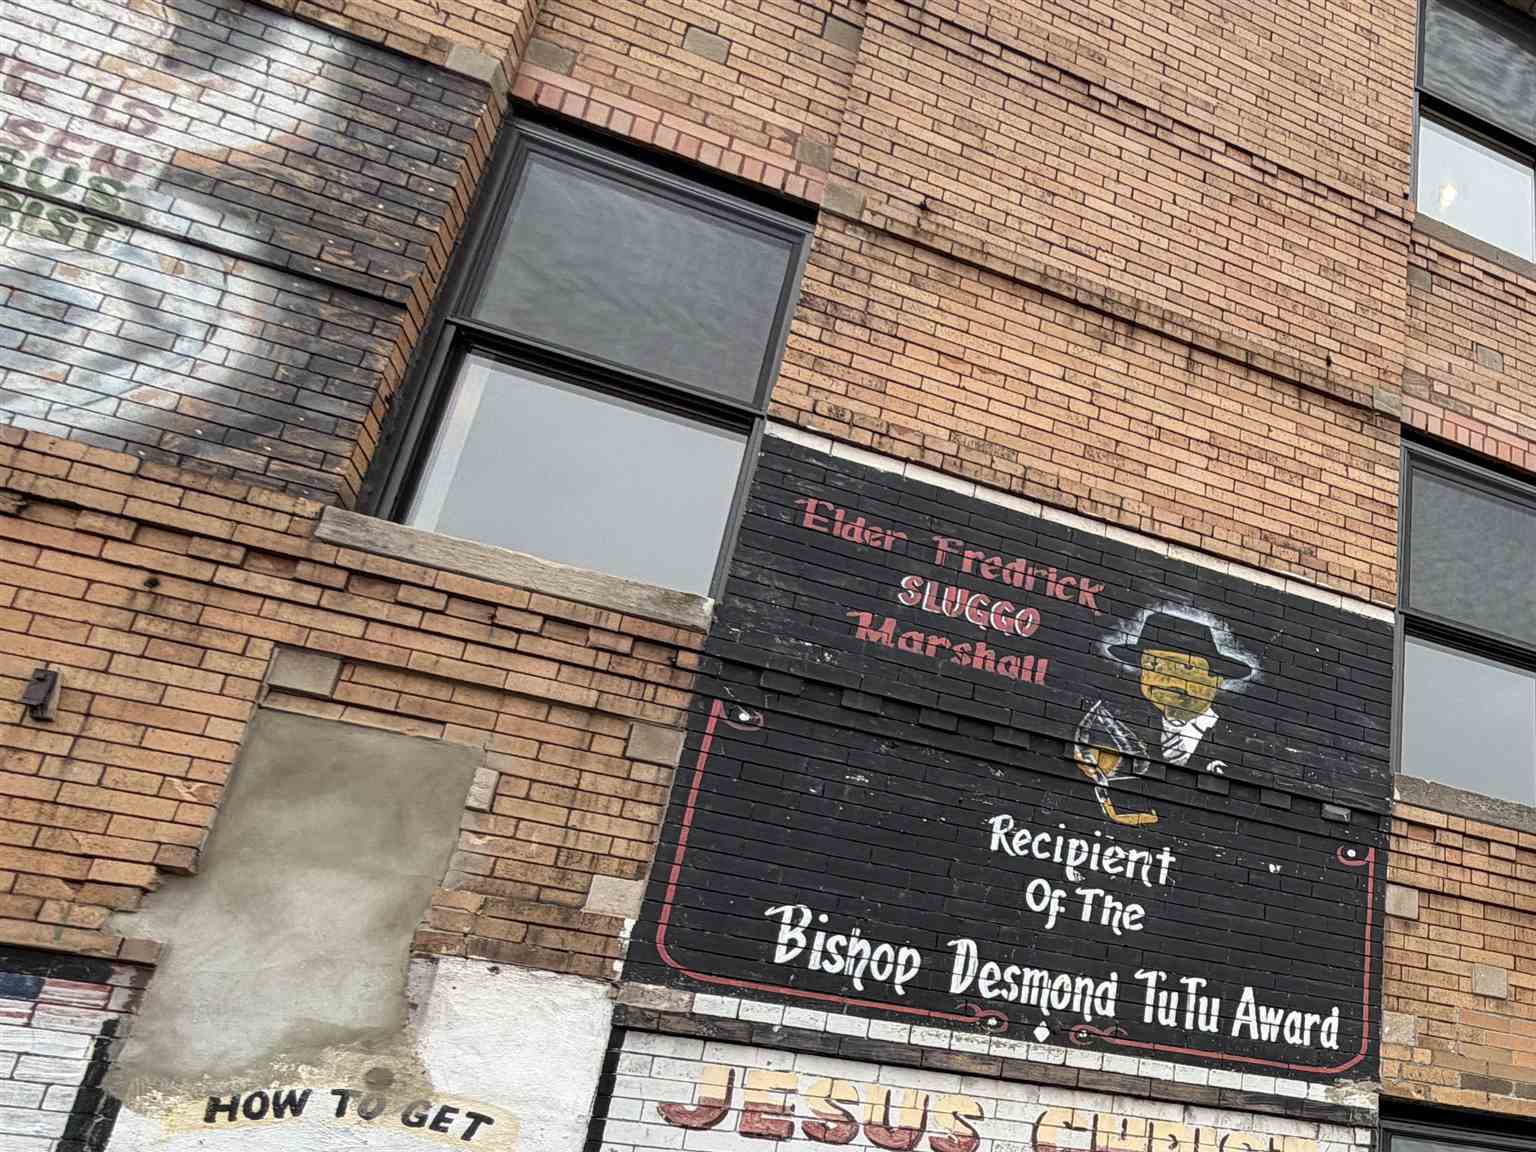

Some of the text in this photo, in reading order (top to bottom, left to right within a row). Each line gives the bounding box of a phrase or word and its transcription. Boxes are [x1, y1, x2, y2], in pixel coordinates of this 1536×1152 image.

[795, 496, 1107, 616] Elder Fredrick
[898, 574, 1041, 638] SLUGGO
[847, 610, 1050, 687] Marshall
[988, 814, 1177, 887] Recipient
[1025, 878, 1146, 935] Of The
[763, 904, 1340, 1050] Bishop Desmond TuTu Award
[203, 1088, 495, 1143] HOW TO GET
